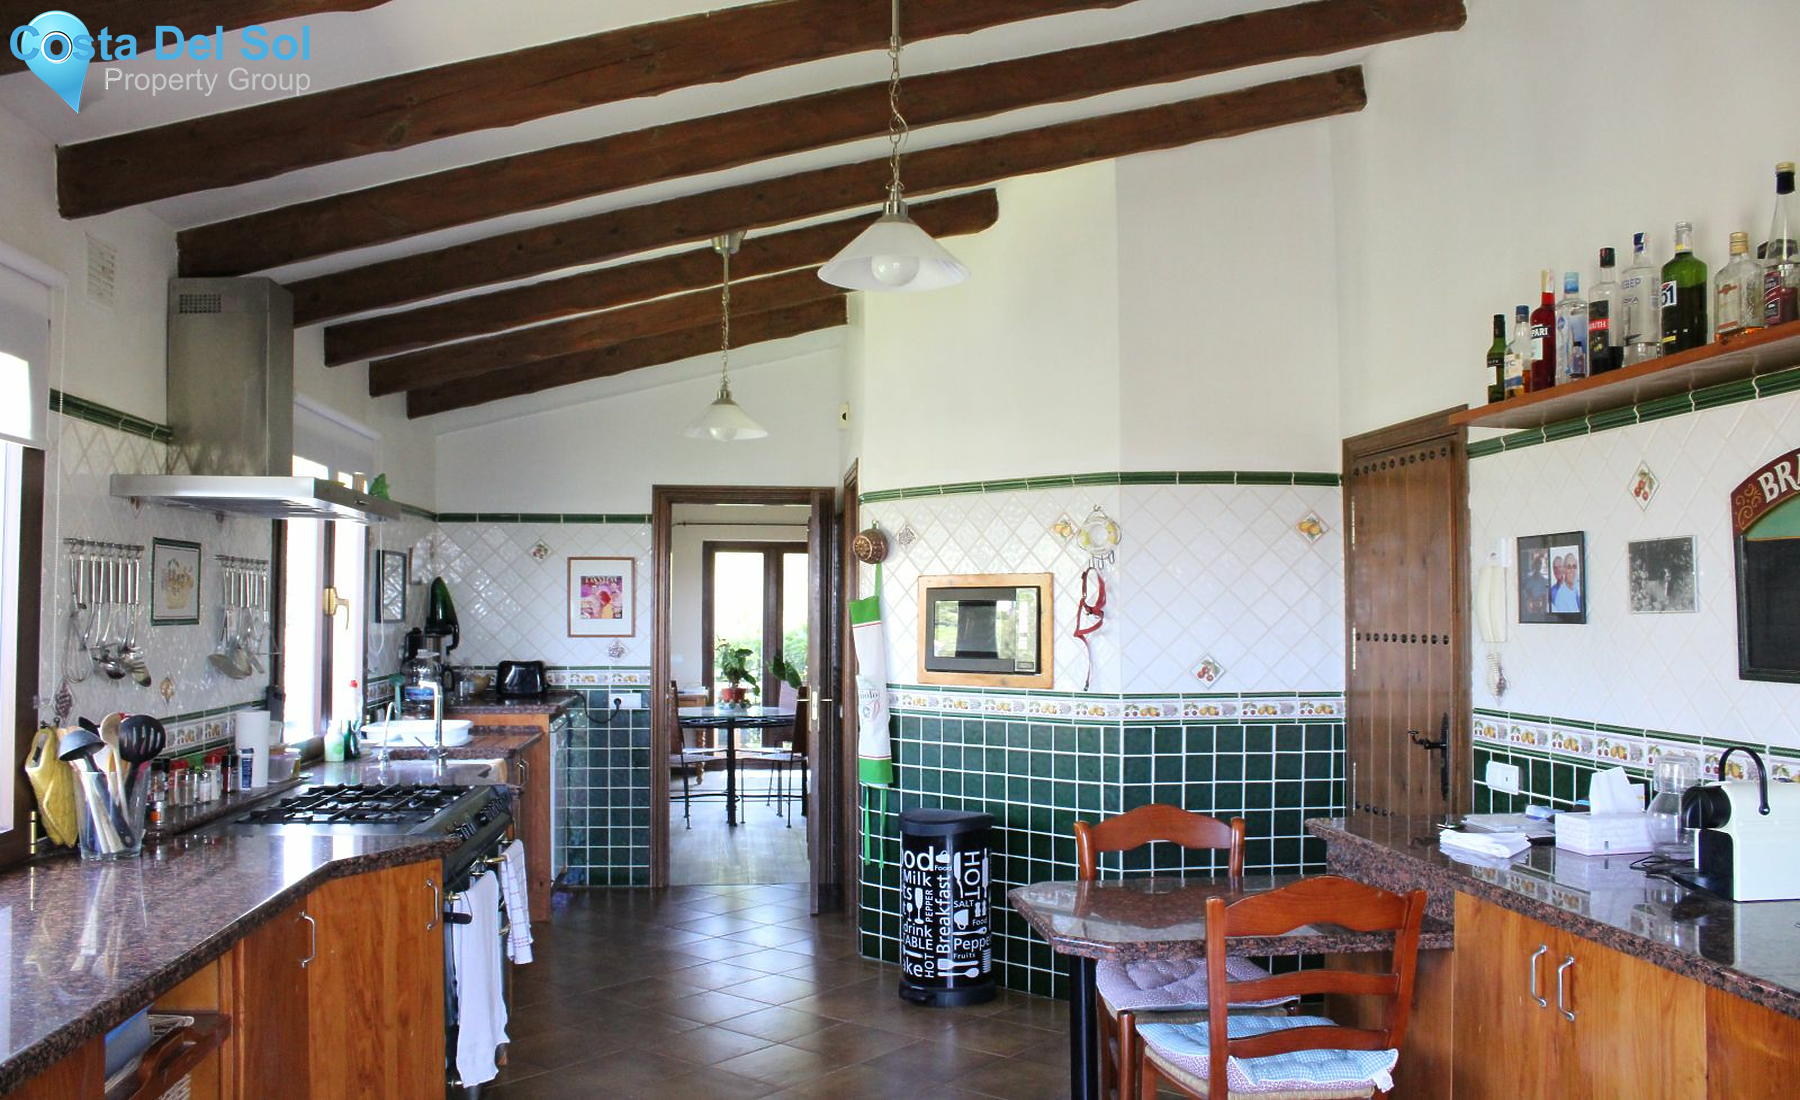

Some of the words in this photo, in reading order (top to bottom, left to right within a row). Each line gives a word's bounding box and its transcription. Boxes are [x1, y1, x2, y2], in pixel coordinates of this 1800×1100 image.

[1757, 453, 1800, 504] BR
[903, 869, 933, 887] Milk
[963, 851, 981, 900] HOT
[925, 889, 934, 923] PEPPER
[935, 874, 952, 953] Breakfast
[903, 920, 933, 938] drink
[924, 953, 935, 978] HOT
[953, 951, 975, 959] Fruits
